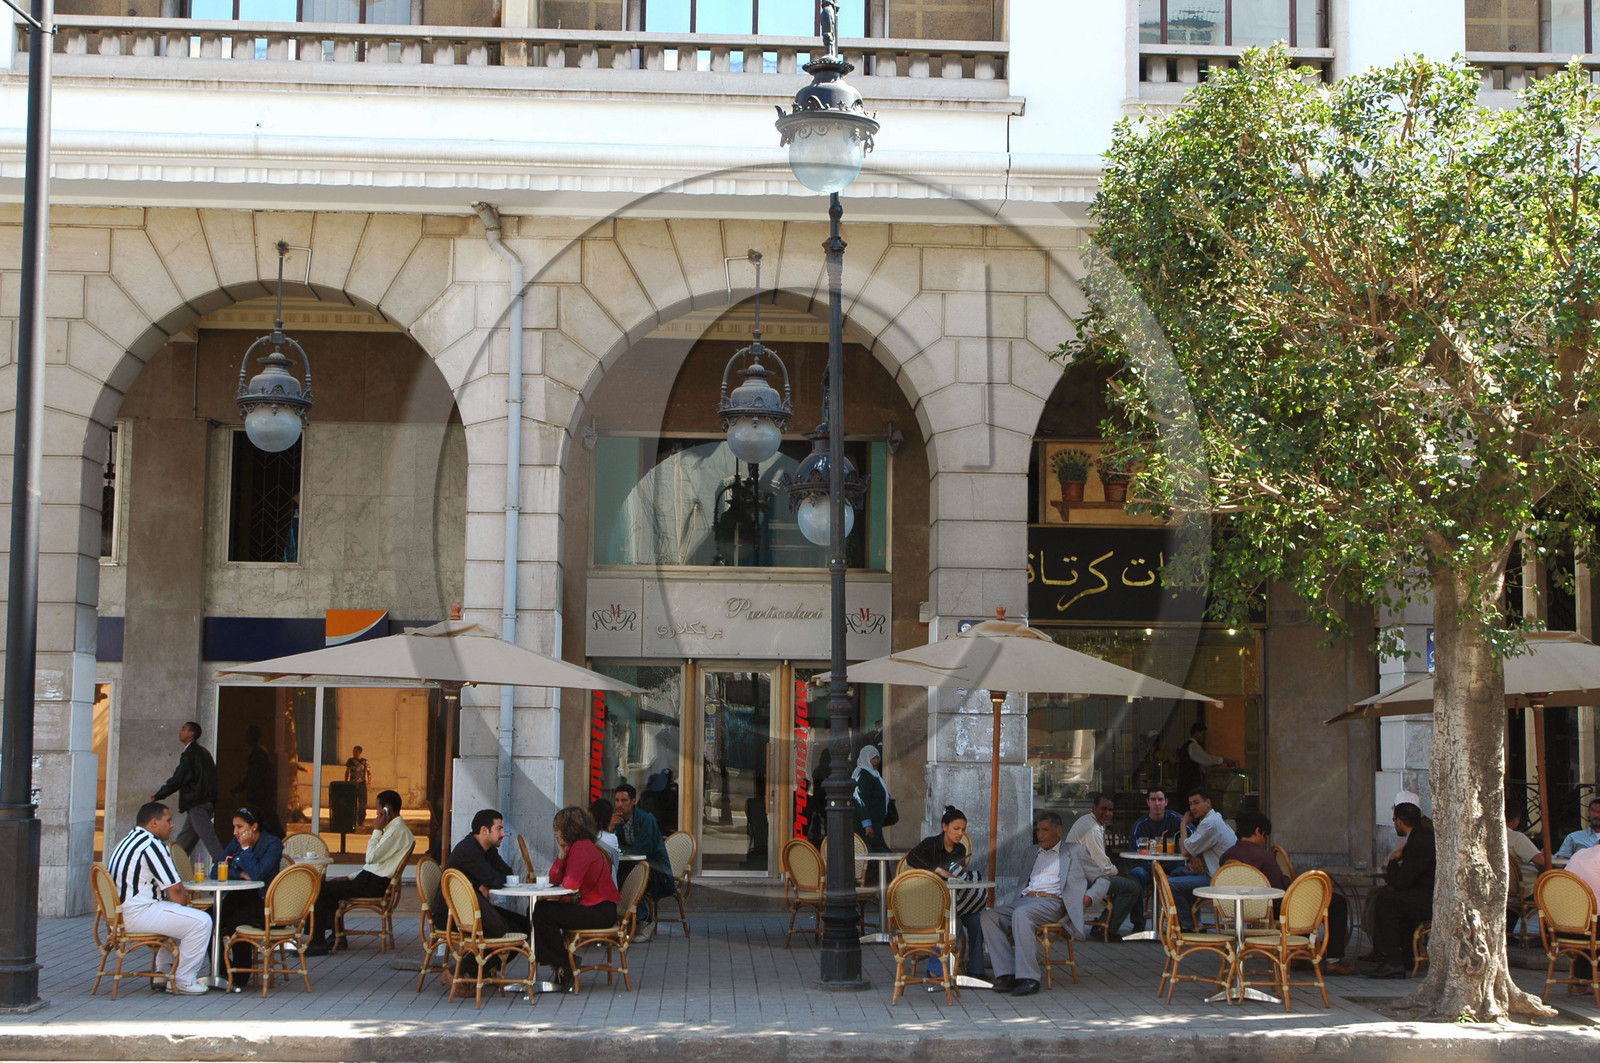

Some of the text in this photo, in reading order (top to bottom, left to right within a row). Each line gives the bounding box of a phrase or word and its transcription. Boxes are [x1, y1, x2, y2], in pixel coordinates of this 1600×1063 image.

[725, 597, 825, 620] Particolari
[590, 689, 606, 803] omotio
[794, 679, 810, 841] Promotion
